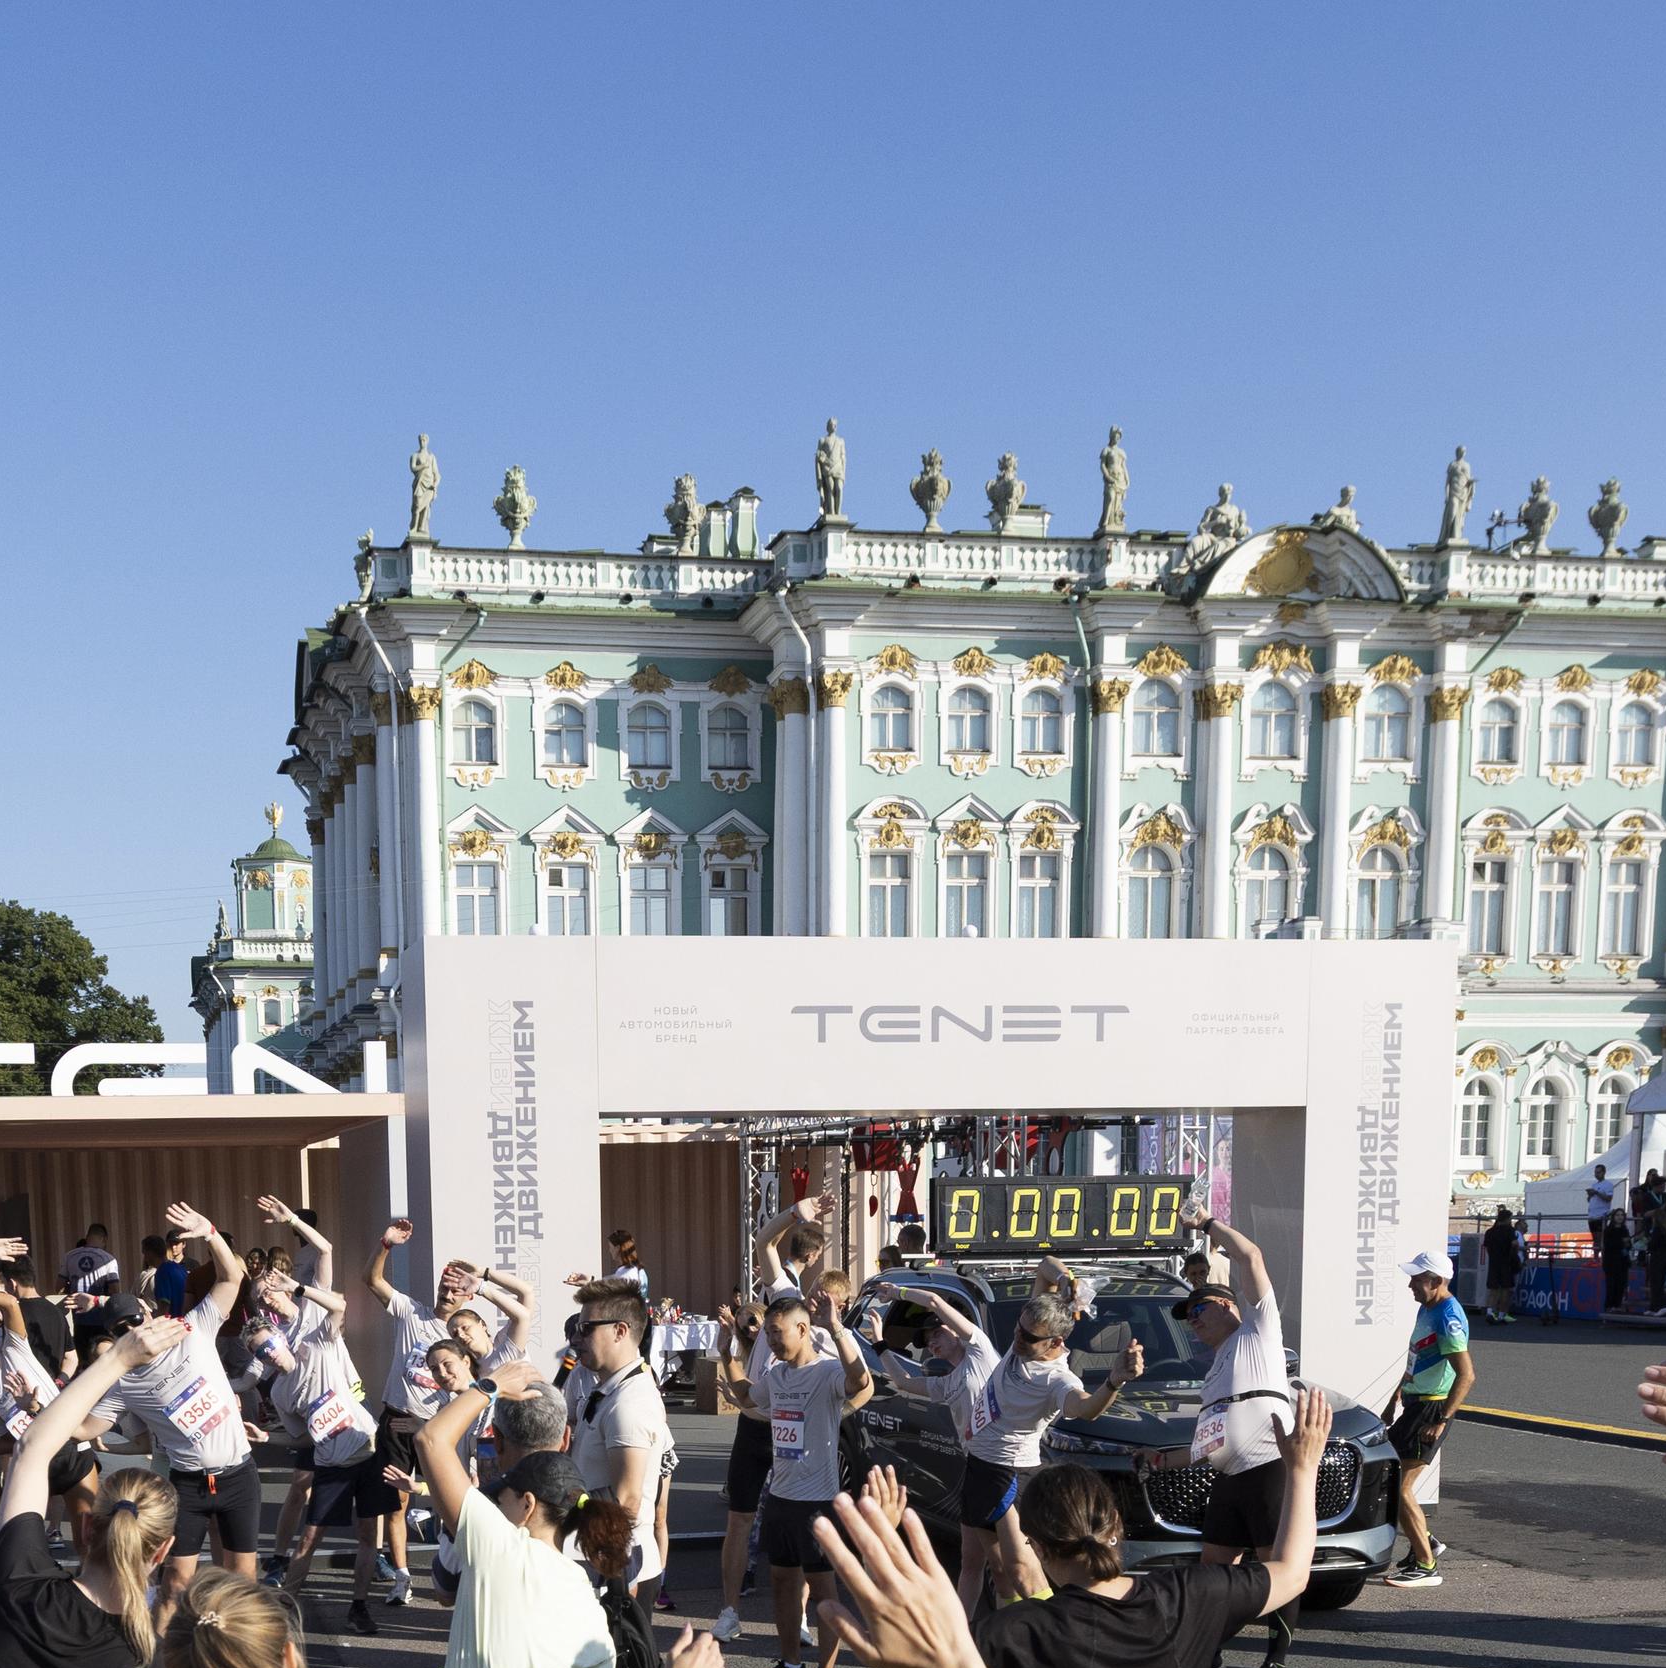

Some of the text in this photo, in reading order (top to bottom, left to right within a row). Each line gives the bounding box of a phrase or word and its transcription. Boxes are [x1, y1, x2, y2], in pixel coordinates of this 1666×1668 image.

[619, 1019, 733, 1029] АВТОМОБИЛЬНЫЙ
[653, 1005, 698, 1015] НОВЫЙ
[790, 1005, 1130, 1043] TENET
[655, 1034, 698, 1044] БРЕНД
[513, 1000, 544, 1240] ДВИЖЕНИЕМ
[1379, 1002, 1403, 1225] ДВИЖЕНИЕМ
[1355, 1105, 1379, 1325] ДВИЖЕНИЕМ
[146, 1354, 191, 1397] TENET
[176, 1389, 220, 1430] 13565
[308, 1401, 346, 1435] 13404
[859, 1409, 903, 1433] TENET
